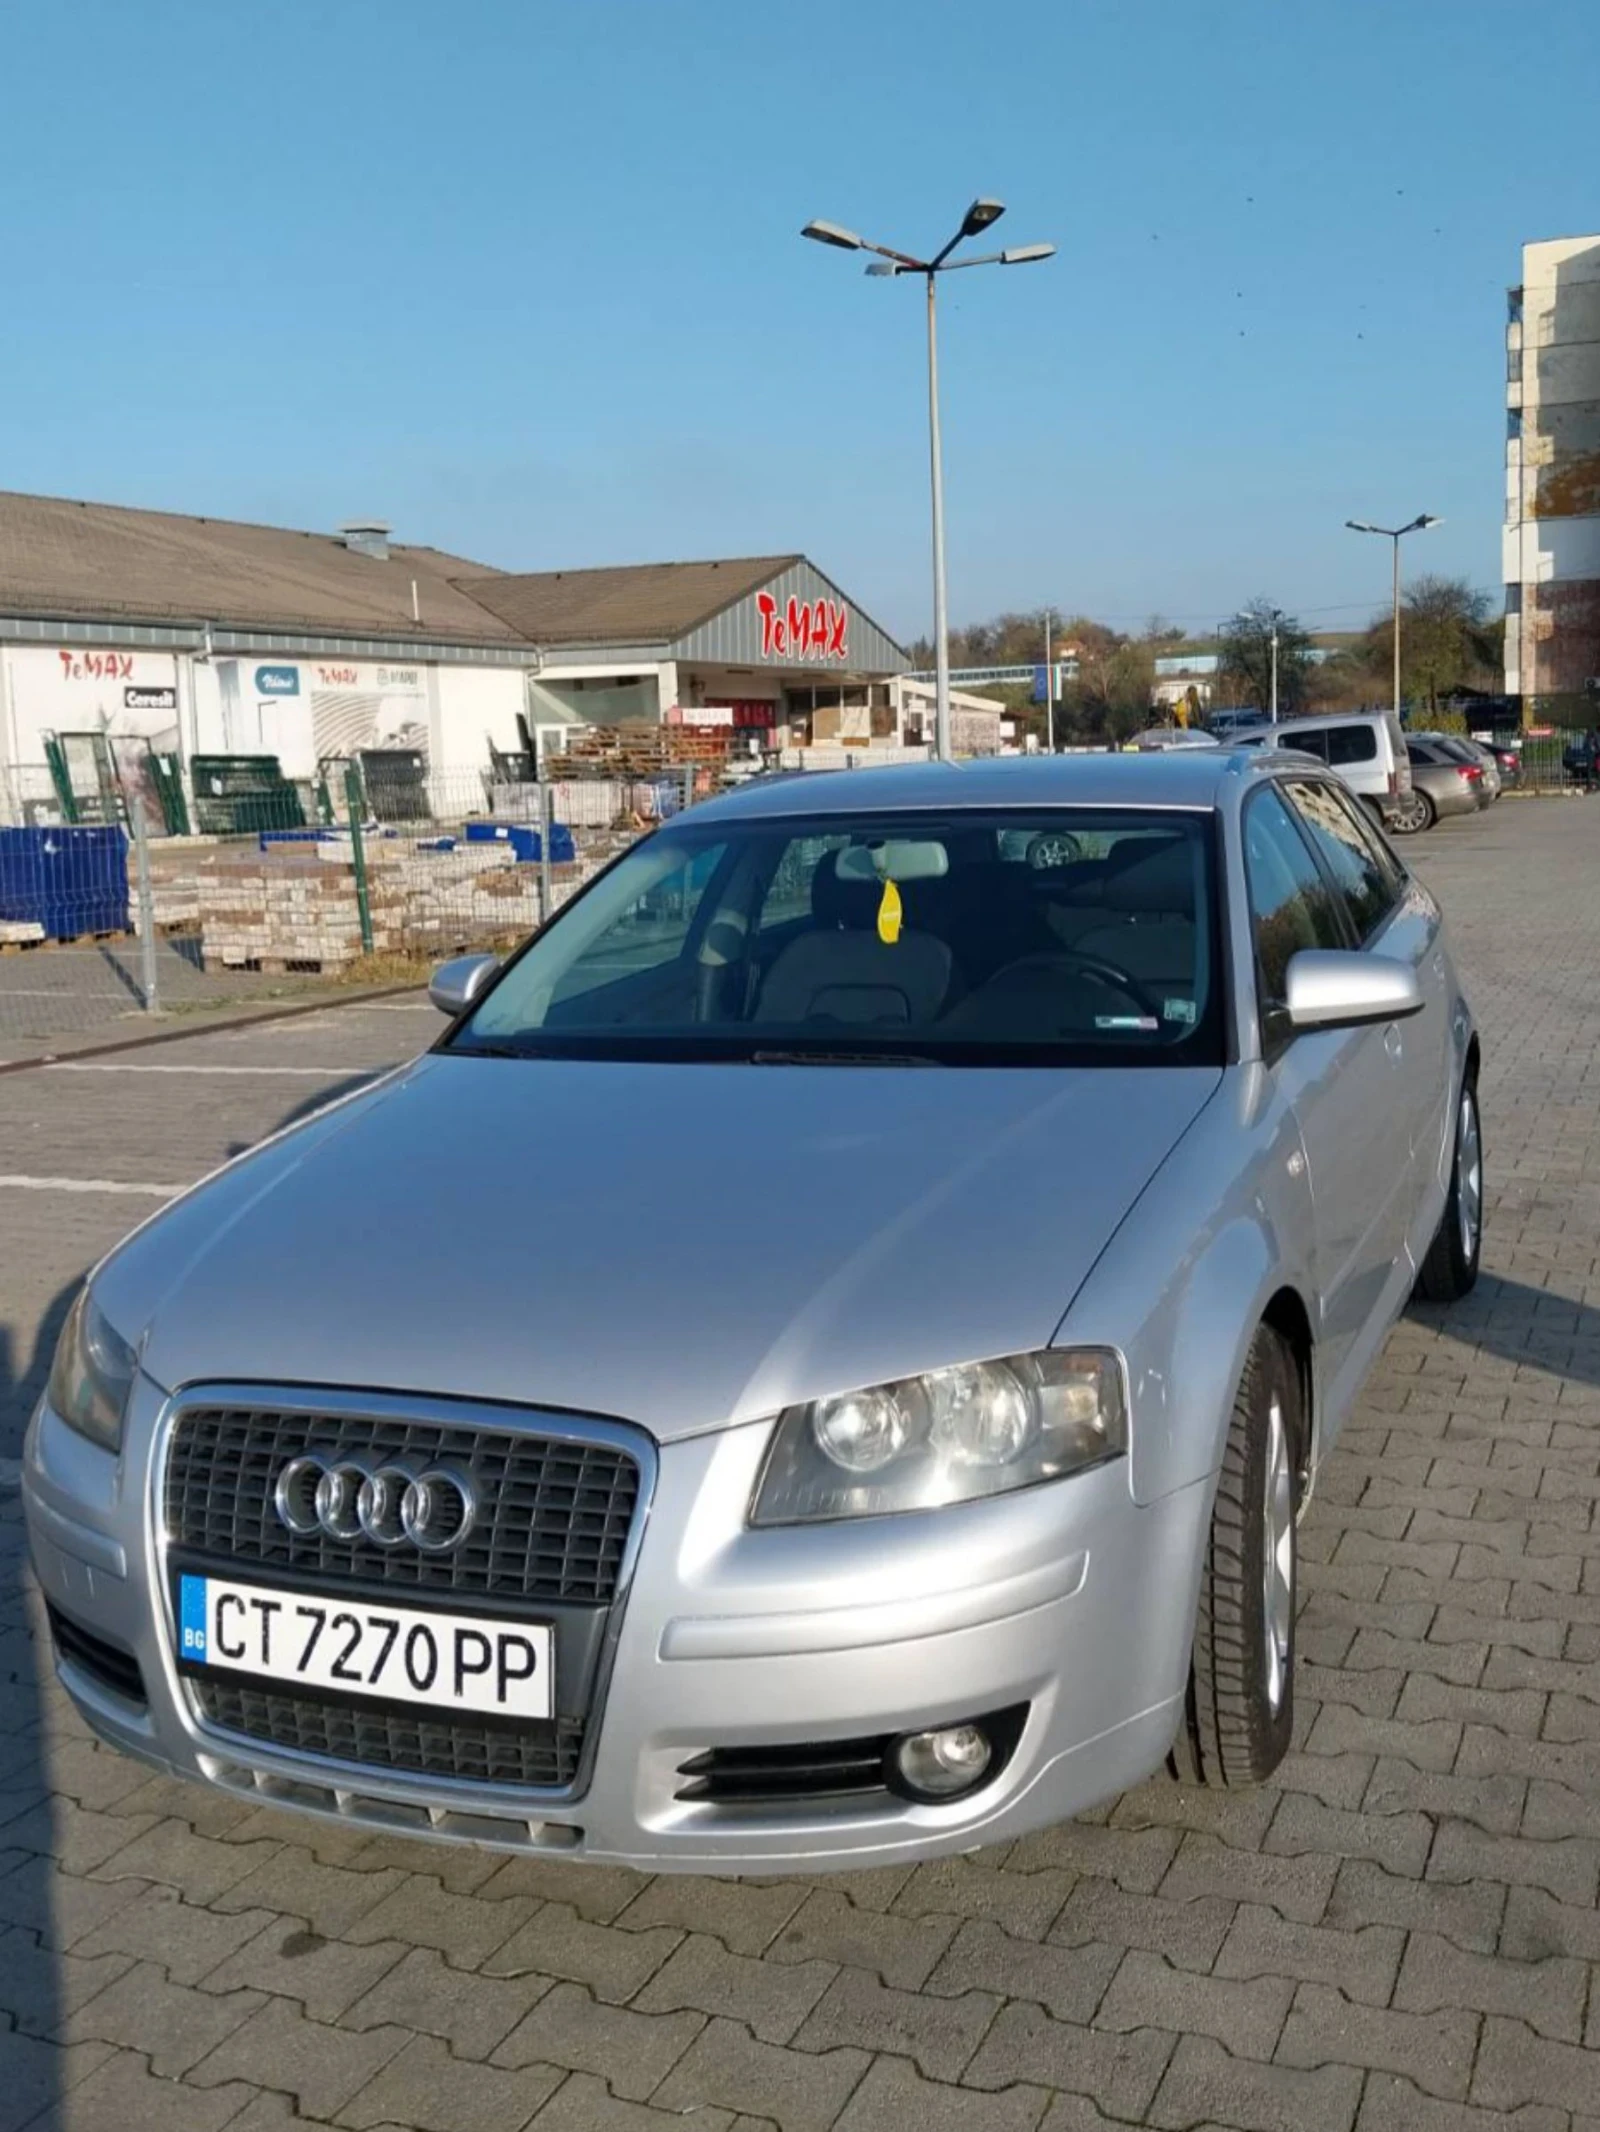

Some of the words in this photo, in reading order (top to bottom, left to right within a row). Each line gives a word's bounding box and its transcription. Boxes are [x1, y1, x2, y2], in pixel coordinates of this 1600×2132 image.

[757, 592, 847, 661] TeMAX
[59, 651, 133, 681] TeMAX
[183, 1627, 205, 1649] BG
[215, 1593, 281, 1665] CT
[296, 1605, 438, 1691] 7270
[454, 1628, 537, 1703] PP
